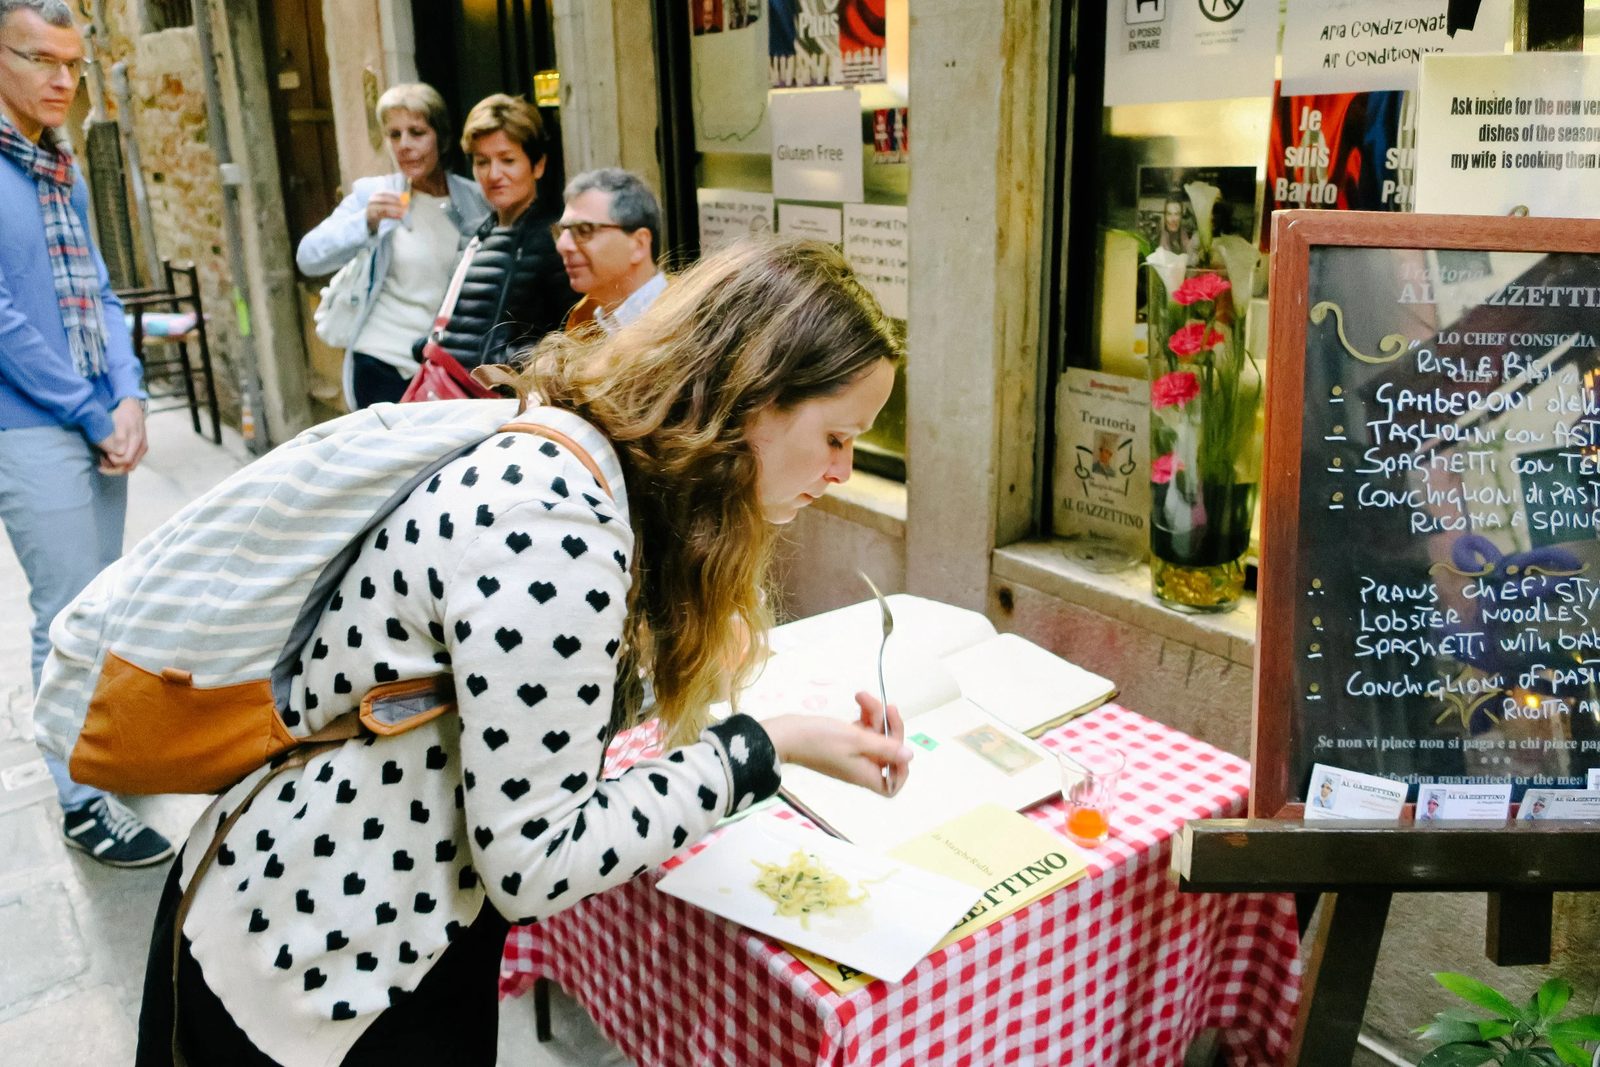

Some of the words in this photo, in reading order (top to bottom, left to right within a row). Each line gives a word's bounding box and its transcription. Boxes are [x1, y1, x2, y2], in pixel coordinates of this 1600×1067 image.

[1139, 27, 1161, 37] POSSO
[1128, 40, 1160, 51] ENTRARE
[1451, 97, 1472, 115] Ask
[1475, 97, 1512, 115] inside
[1515, 97, 1532, 115] for
[1535, 98, 1554, 115] the
[1556, 100, 1581, 115] new
[1299, 105, 1322, 131] Je
[1480, 124, 1519, 142] dishes
[1522, 124, 1534, 142] of
[1536, 125, 1555, 142] the
[777, 144, 814, 160] Gluten
[817, 144, 844, 161] Free
[1285, 145, 1330, 168] suis
[1451, 153, 1469, 170] my
[1472, 151, 1496, 168] wife
[1502, 151, 1512, 168] is
[1516, 151, 1562, 170] cooking
[1566, 152, 1595, 168] them
[1275, 178, 1338, 204] Bardo
[1438, 332, 1460, 346] LO
[1463, 332, 1506, 346] CHEF
[1080, 409, 1136, 433] Trattoria
[1063, 498, 1075, 511] AL
[1076, 502, 1144, 529] GAZZETTINO
[1317, 735, 1334, 748] Se
[1337, 740, 1362, 748] non
[1366, 736, 1378, 748] vi
[1420, 740, 1444, 748] non
[1448, 737, 1460, 748] si
[1463, 740, 1494, 751] paga
[1508, 740, 1517, 748] a
[1520, 737, 1541, 749] chi
[1515, 775, 1531, 785] or
[1533, 773, 1554, 785] the
